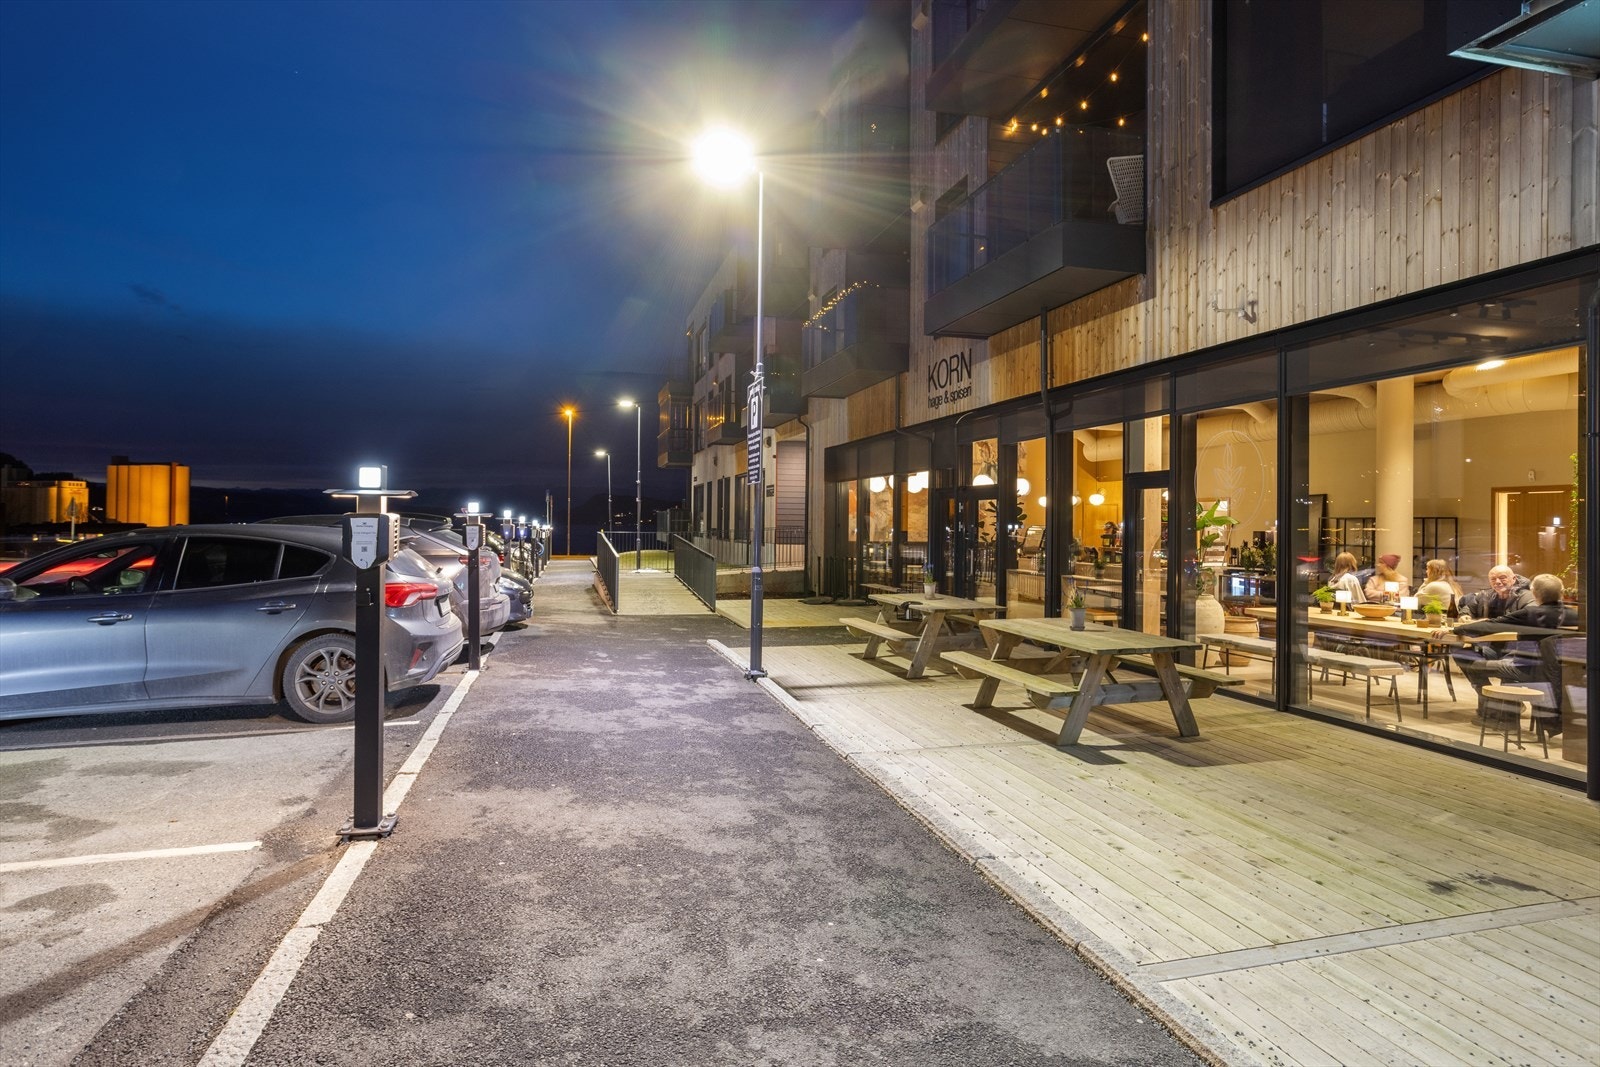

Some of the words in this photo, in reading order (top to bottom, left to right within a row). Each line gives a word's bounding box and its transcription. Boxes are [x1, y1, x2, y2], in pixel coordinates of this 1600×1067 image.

[928, 348, 972, 393] KORN
[928, 395, 943, 410] hage
[944, 390, 950, 403] &
[950, 382, 972, 404] spiseri
